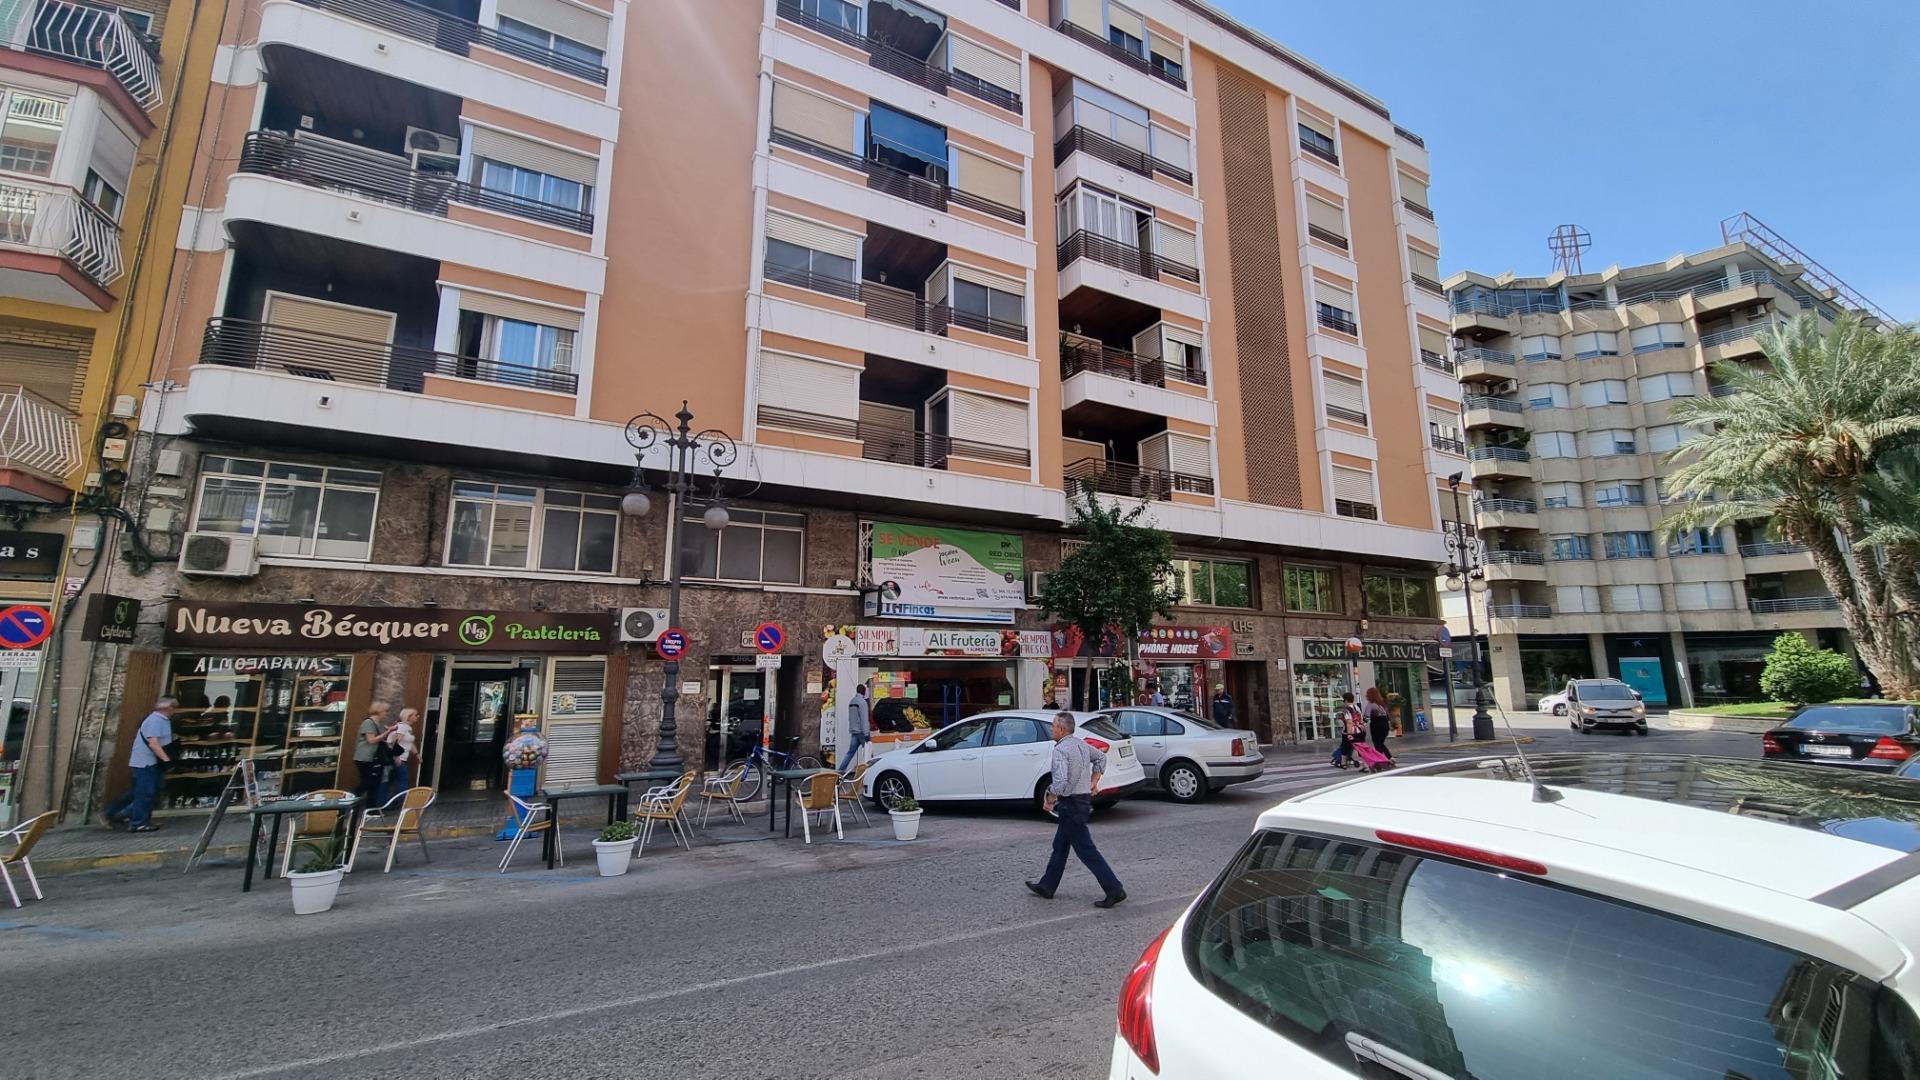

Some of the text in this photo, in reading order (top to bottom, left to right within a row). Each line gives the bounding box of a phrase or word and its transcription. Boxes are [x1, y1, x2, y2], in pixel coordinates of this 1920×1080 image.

[879, 533, 940, 549] SE VENDE
[101, 624, 132, 640] Cafetería
[176, 607, 449, 644] Nueva Bécquer
[465, 622, 601, 641] NB Pastelería
[859, 629, 894, 640] SIEMPRE
[929, 632, 996, 647] Ali Frutería
[1021, 634, 1049, 644] SIEMPRE
[859, 641, 894, 652] OFERTA
[1021, 645, 1050, 654] FRESCA
[1139, 643, 1199, 655] PHONE HOUSE
[1306, 642, 1423, 660] CONFIERIA RUIZ
